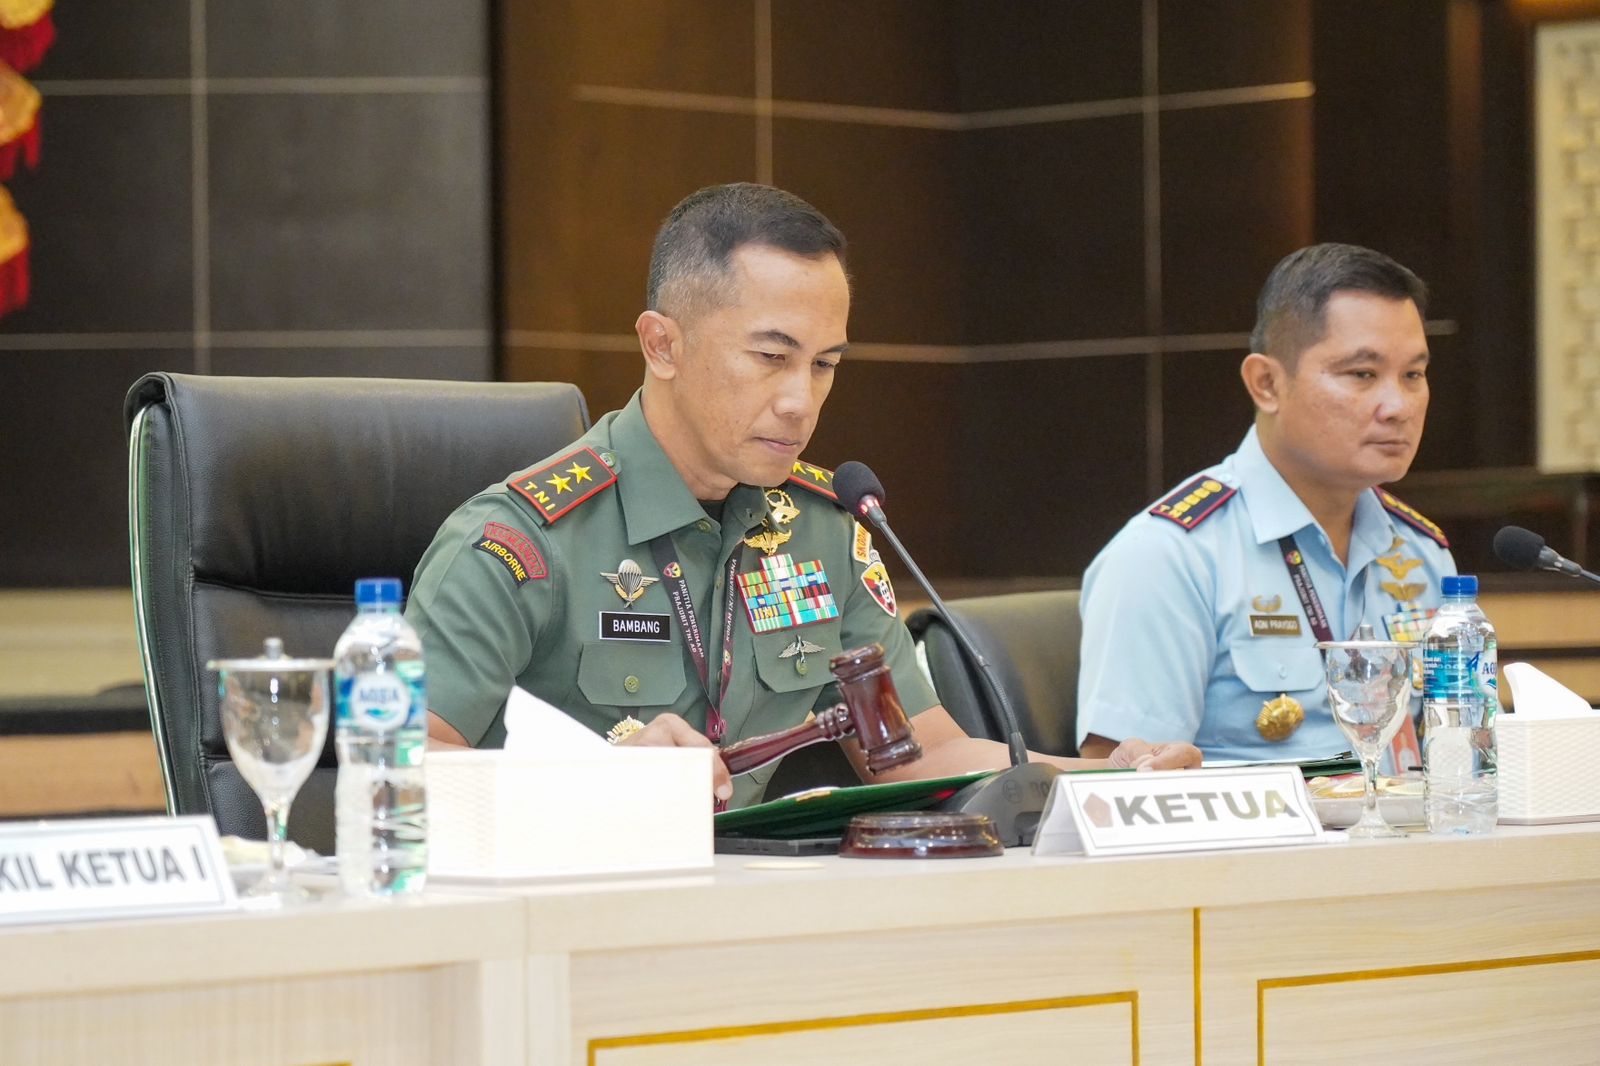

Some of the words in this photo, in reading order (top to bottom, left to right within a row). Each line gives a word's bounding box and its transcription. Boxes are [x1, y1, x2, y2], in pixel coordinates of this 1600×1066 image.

[524, 481, 556, 511] TNI
[480, 539, 527, 582] AIRBORNE
[672, 591, 689, 627] PRAJURIT
[678, 579, 692, 610] PANITIA
[612, 619, 660, 634] BAMBANG
[1482, 662, 1498, 675] AQ
[1114, 790, 1300, 826] KETUA
[59, 845, 186, 888] KETUA
